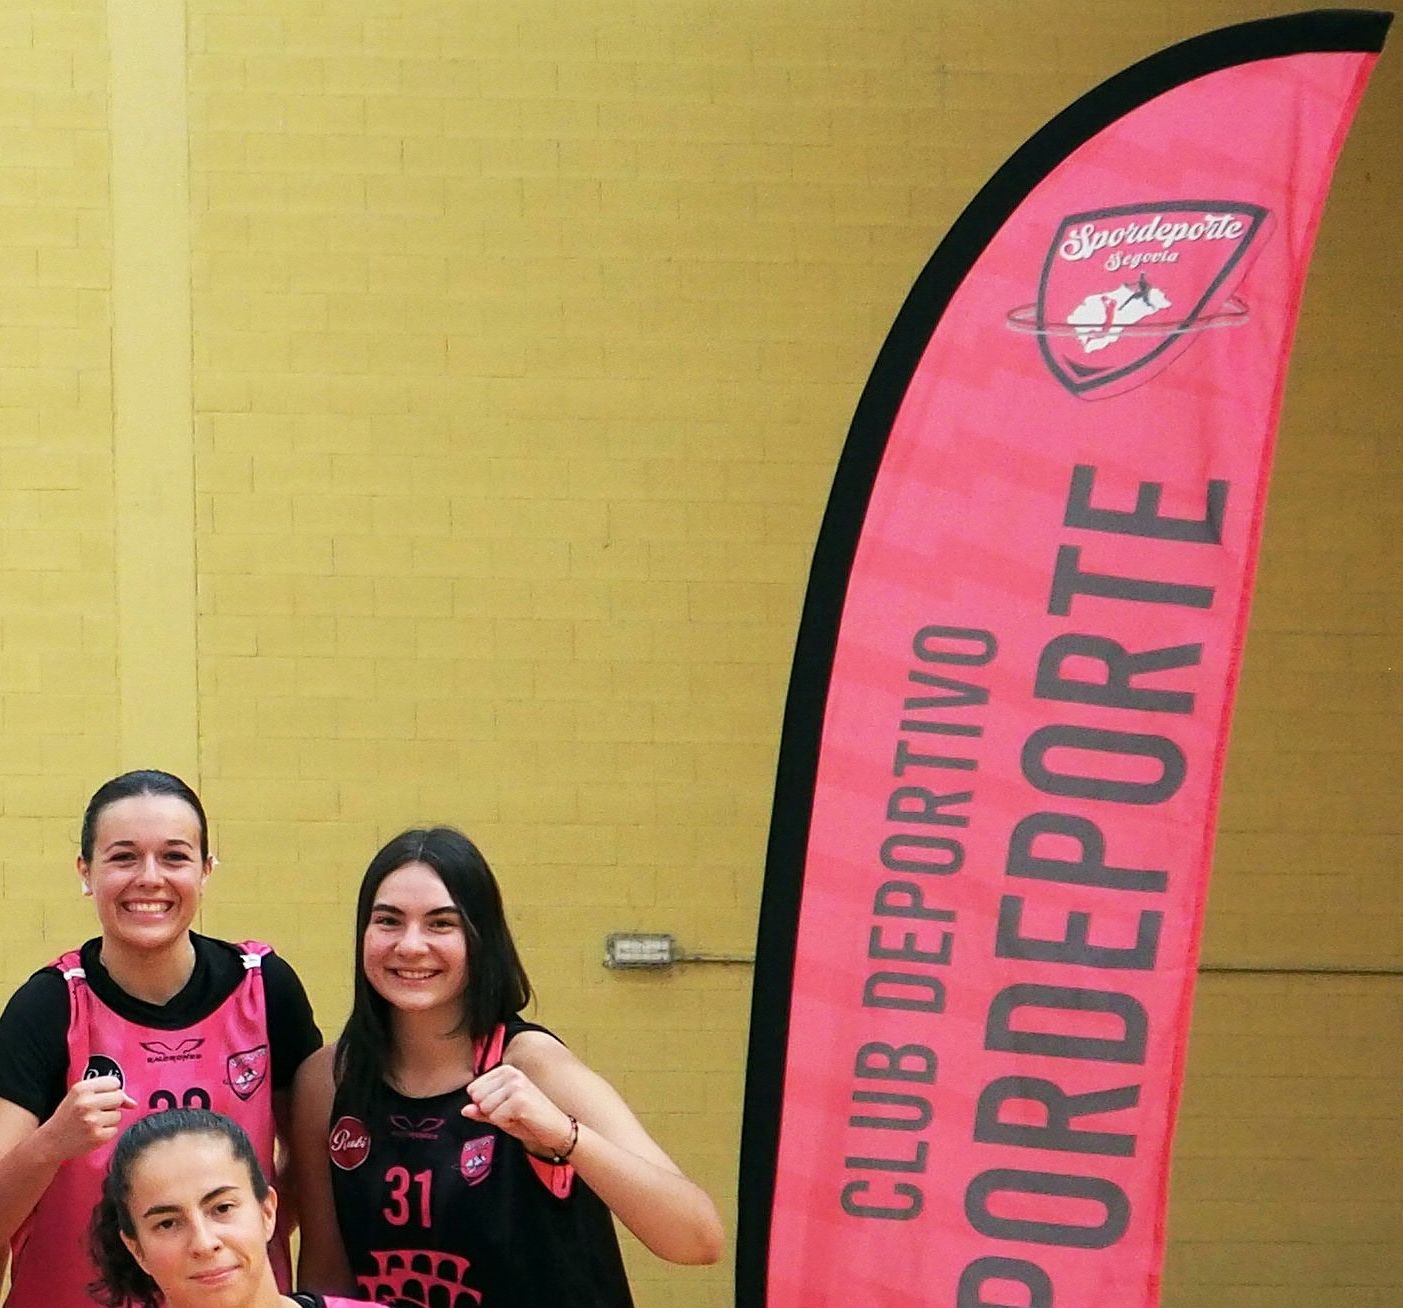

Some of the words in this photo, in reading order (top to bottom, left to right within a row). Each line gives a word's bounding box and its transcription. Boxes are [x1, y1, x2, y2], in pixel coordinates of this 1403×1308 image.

[1059, 212, 1245, 263] Spordeporte
[1104, 249, 1180, 272] Segovia
[863, 622, 999, 1016] DEPORTIVO
[841, 1038, 941, 1223] CLUB
[382, 1166, 433, 1228] 31
